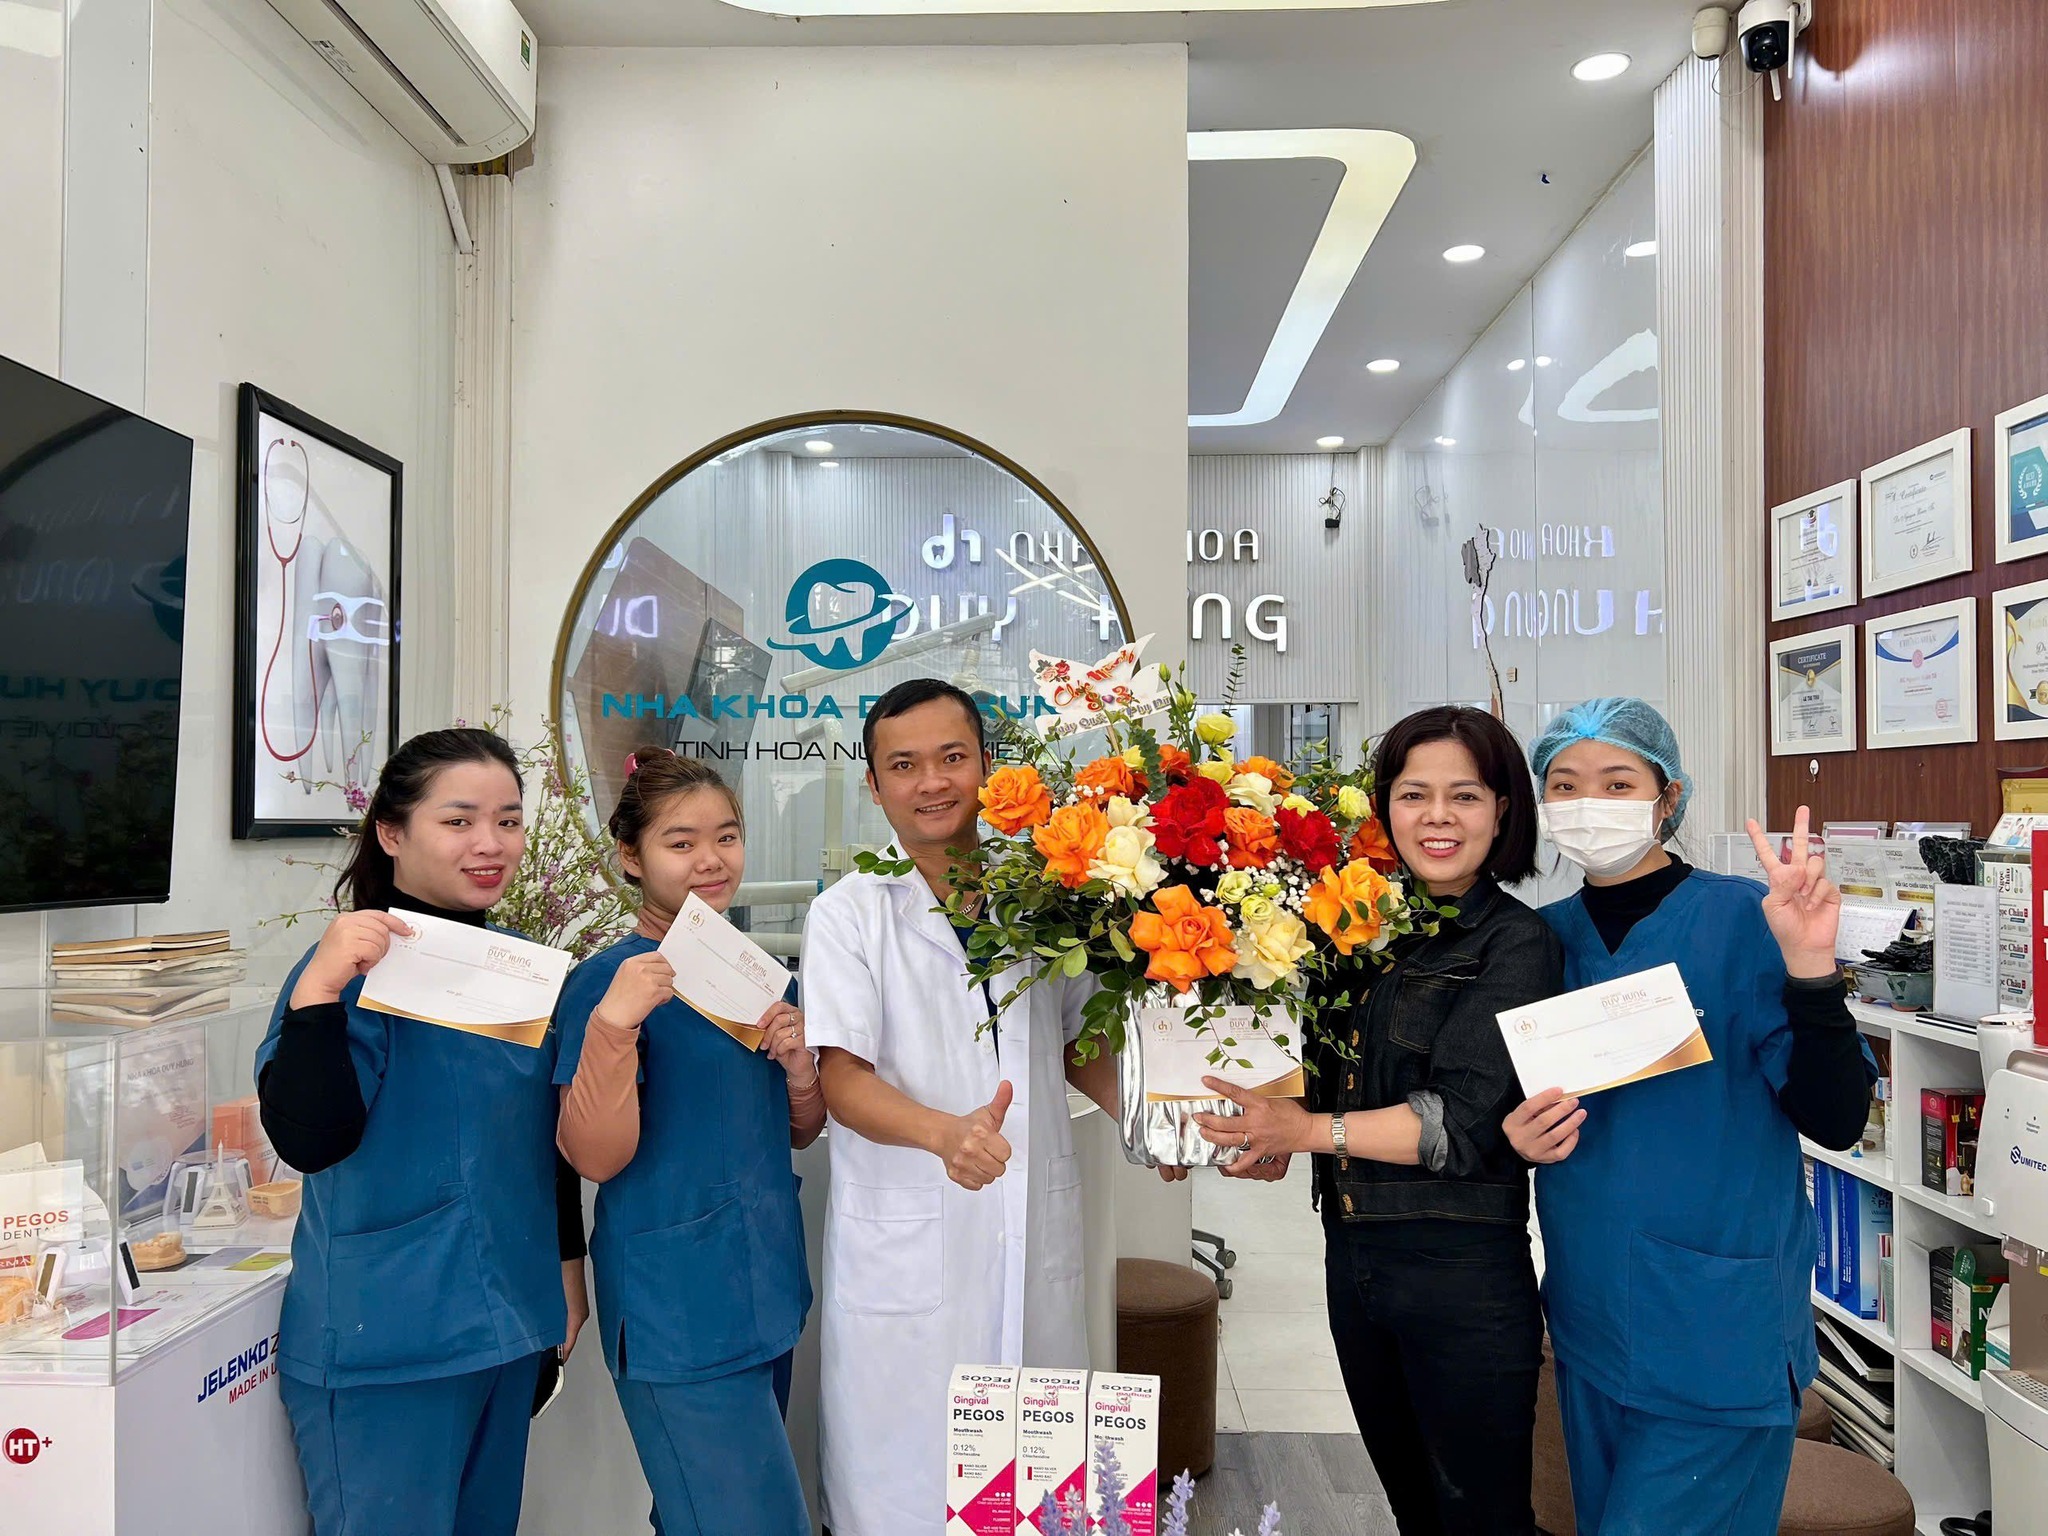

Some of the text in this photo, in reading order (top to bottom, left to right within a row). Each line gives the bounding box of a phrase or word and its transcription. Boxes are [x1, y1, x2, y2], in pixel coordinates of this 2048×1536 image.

[1187, 529, 1259, 563] OA
[1797, 652, 1827, 665] CERTIFICATE
[602, 694, 699, 719] NHA
[712, 694, 844, 719] KHOA
[676, 741, 748, 761] TINH
[756, 741, 826, 761] HOA
[487, 948, 507, 961] DUY
[3, 1210, 69, 1230] PEGOS
[3, 1226, 55, 1241] DENT
[197, 1337, 268, 1404] JELENKO
[228, 1373, 257, 1404] MADE
[259, 1365, 268, 1384] IN
[961, 1374, 1012, 1383] PEGOS
[1030, 1377, 1080, 1385] PEGOS
[1101, 1384, 1152, 1393] PEGOS
[953, 1395, 989, 1407] Gingival
[1023, 1396, 1059, 1408] Gingival
[1095, 1401, 1131, 1413] Gingival
[953, 1408, 1005, 1421] PEGOS
[1022, 1410, 1074, 1423] PEGOS
[1094, 1415, 1146, 1430] PEGOS
